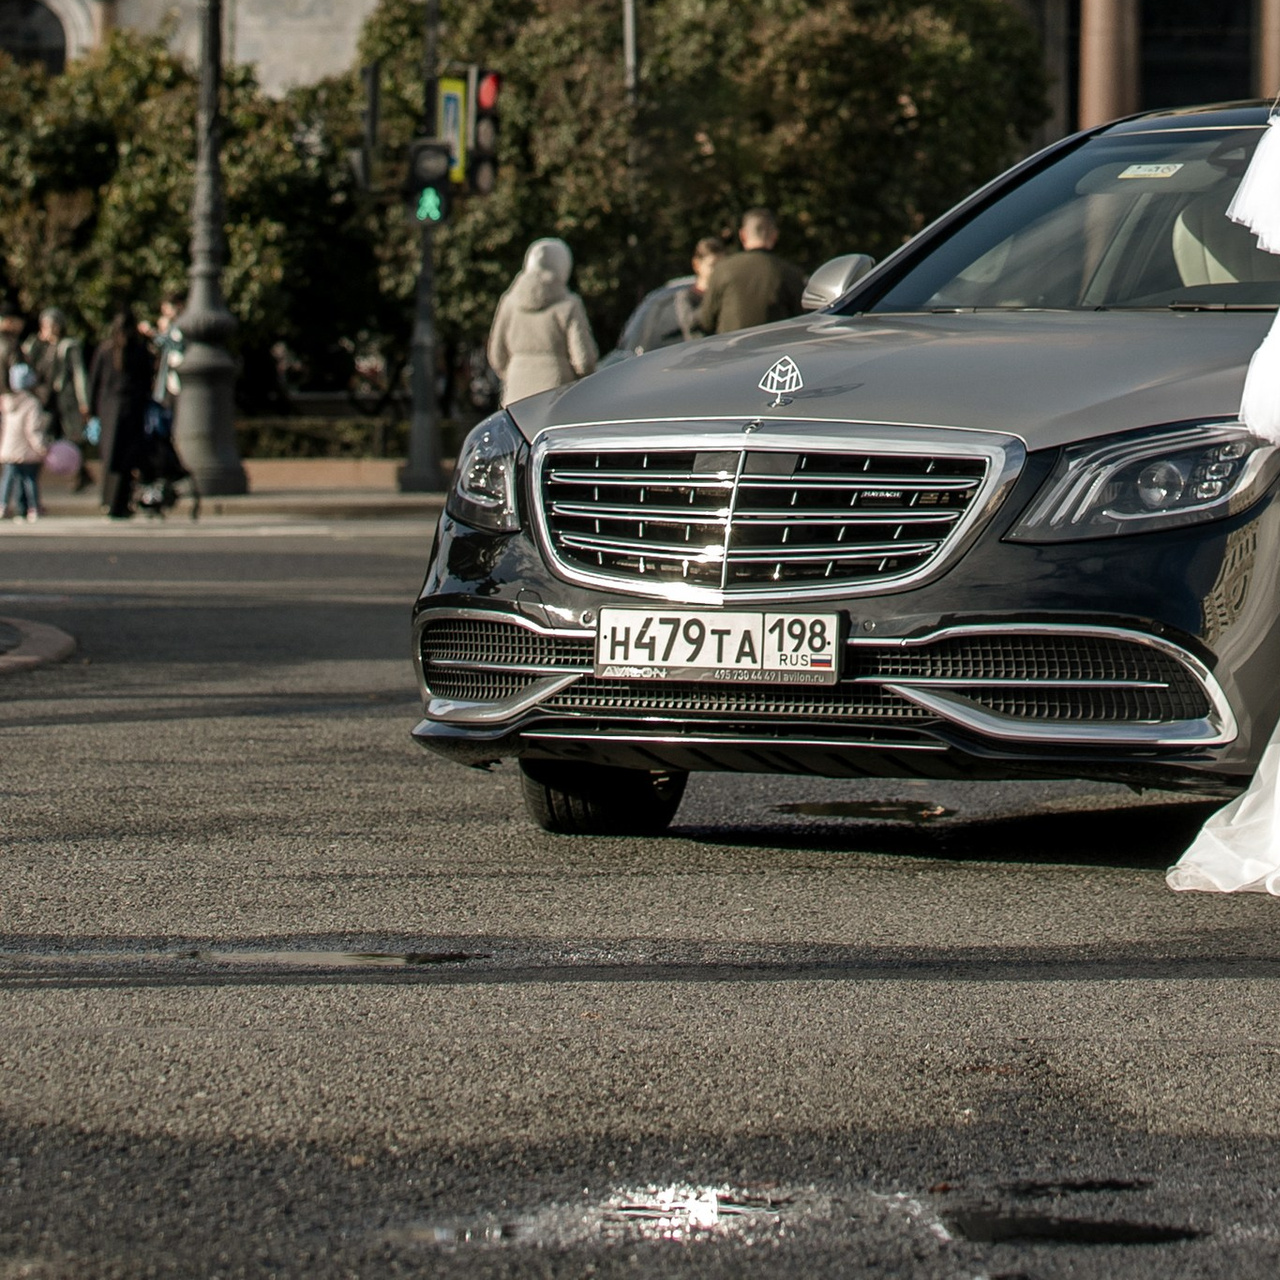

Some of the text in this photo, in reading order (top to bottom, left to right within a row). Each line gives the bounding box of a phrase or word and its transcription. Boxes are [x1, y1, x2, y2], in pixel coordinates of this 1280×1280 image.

[768, 618, 827, 653] 198
[779, 654, 809, 667] RUS
[602, 665, 668, 678] AVILON
[714, 669, 825, 683] 495 730 44 49 avilon.ru
